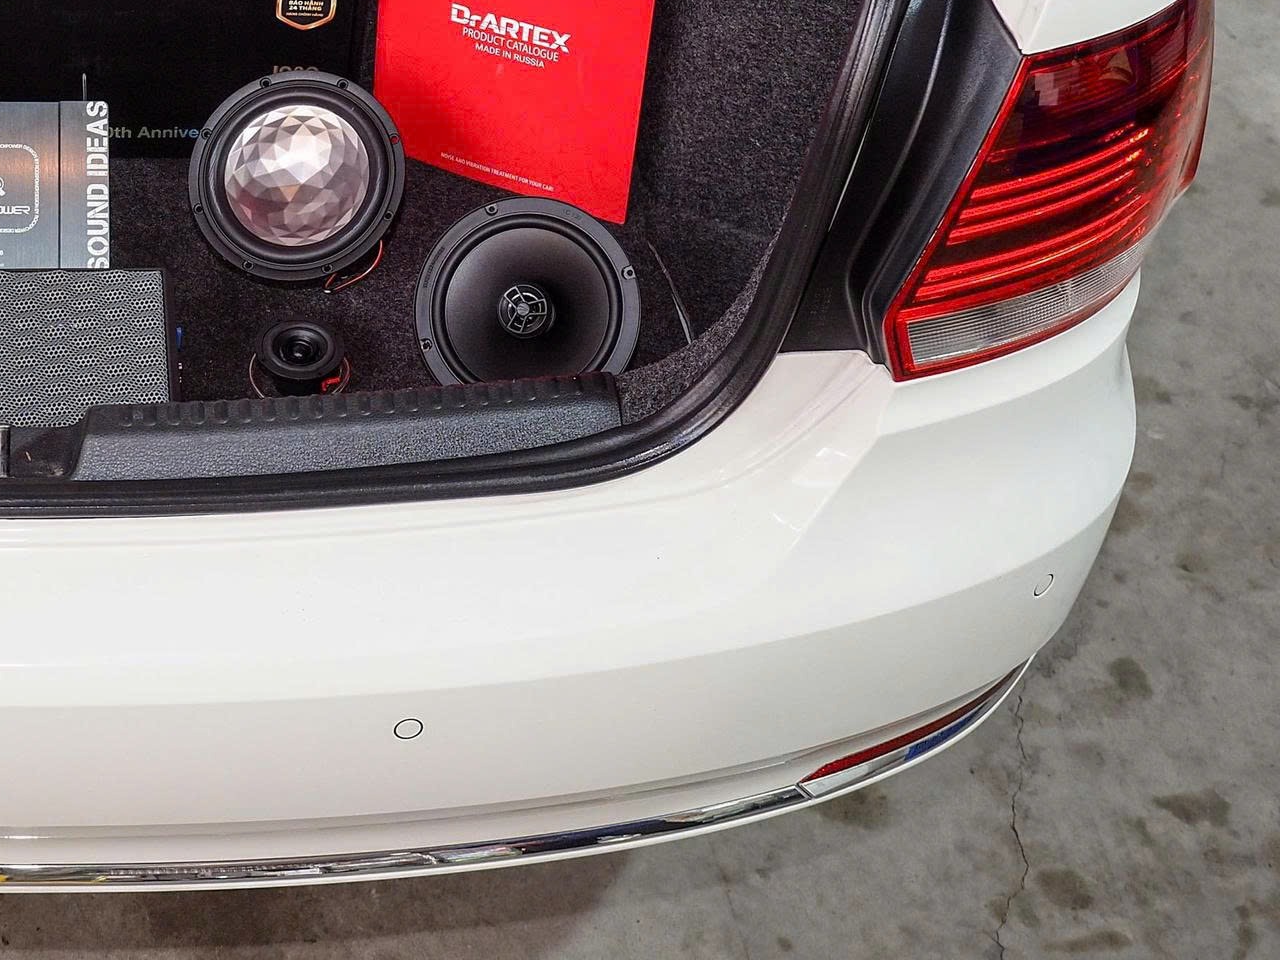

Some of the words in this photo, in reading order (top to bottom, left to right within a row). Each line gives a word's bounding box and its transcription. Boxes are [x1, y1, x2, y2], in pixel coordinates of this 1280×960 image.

[450, 2, 571, 54] DrARTEX
[462, 26, 505, 47] PRODUCT
[506, 39, 560, 62] CATALOGUE
[475, 42, 500, 56] MADE
[502, 50, 512, 59] IN
[513, 54, 545, 68] RUSSIA
[86, 100, 109, 177] IDEAS
[137, 126, 199, 138] Annive
[440, 152, 455, 161] NOISE
[455, 157, 466, 165] AND
[466, 159, 491, 173] VIBRATION
[491, 167, 519, 182] TREATMENT
[529, 179, 542, 188] YOUR
[86, 183, 109, 269] SOUND
